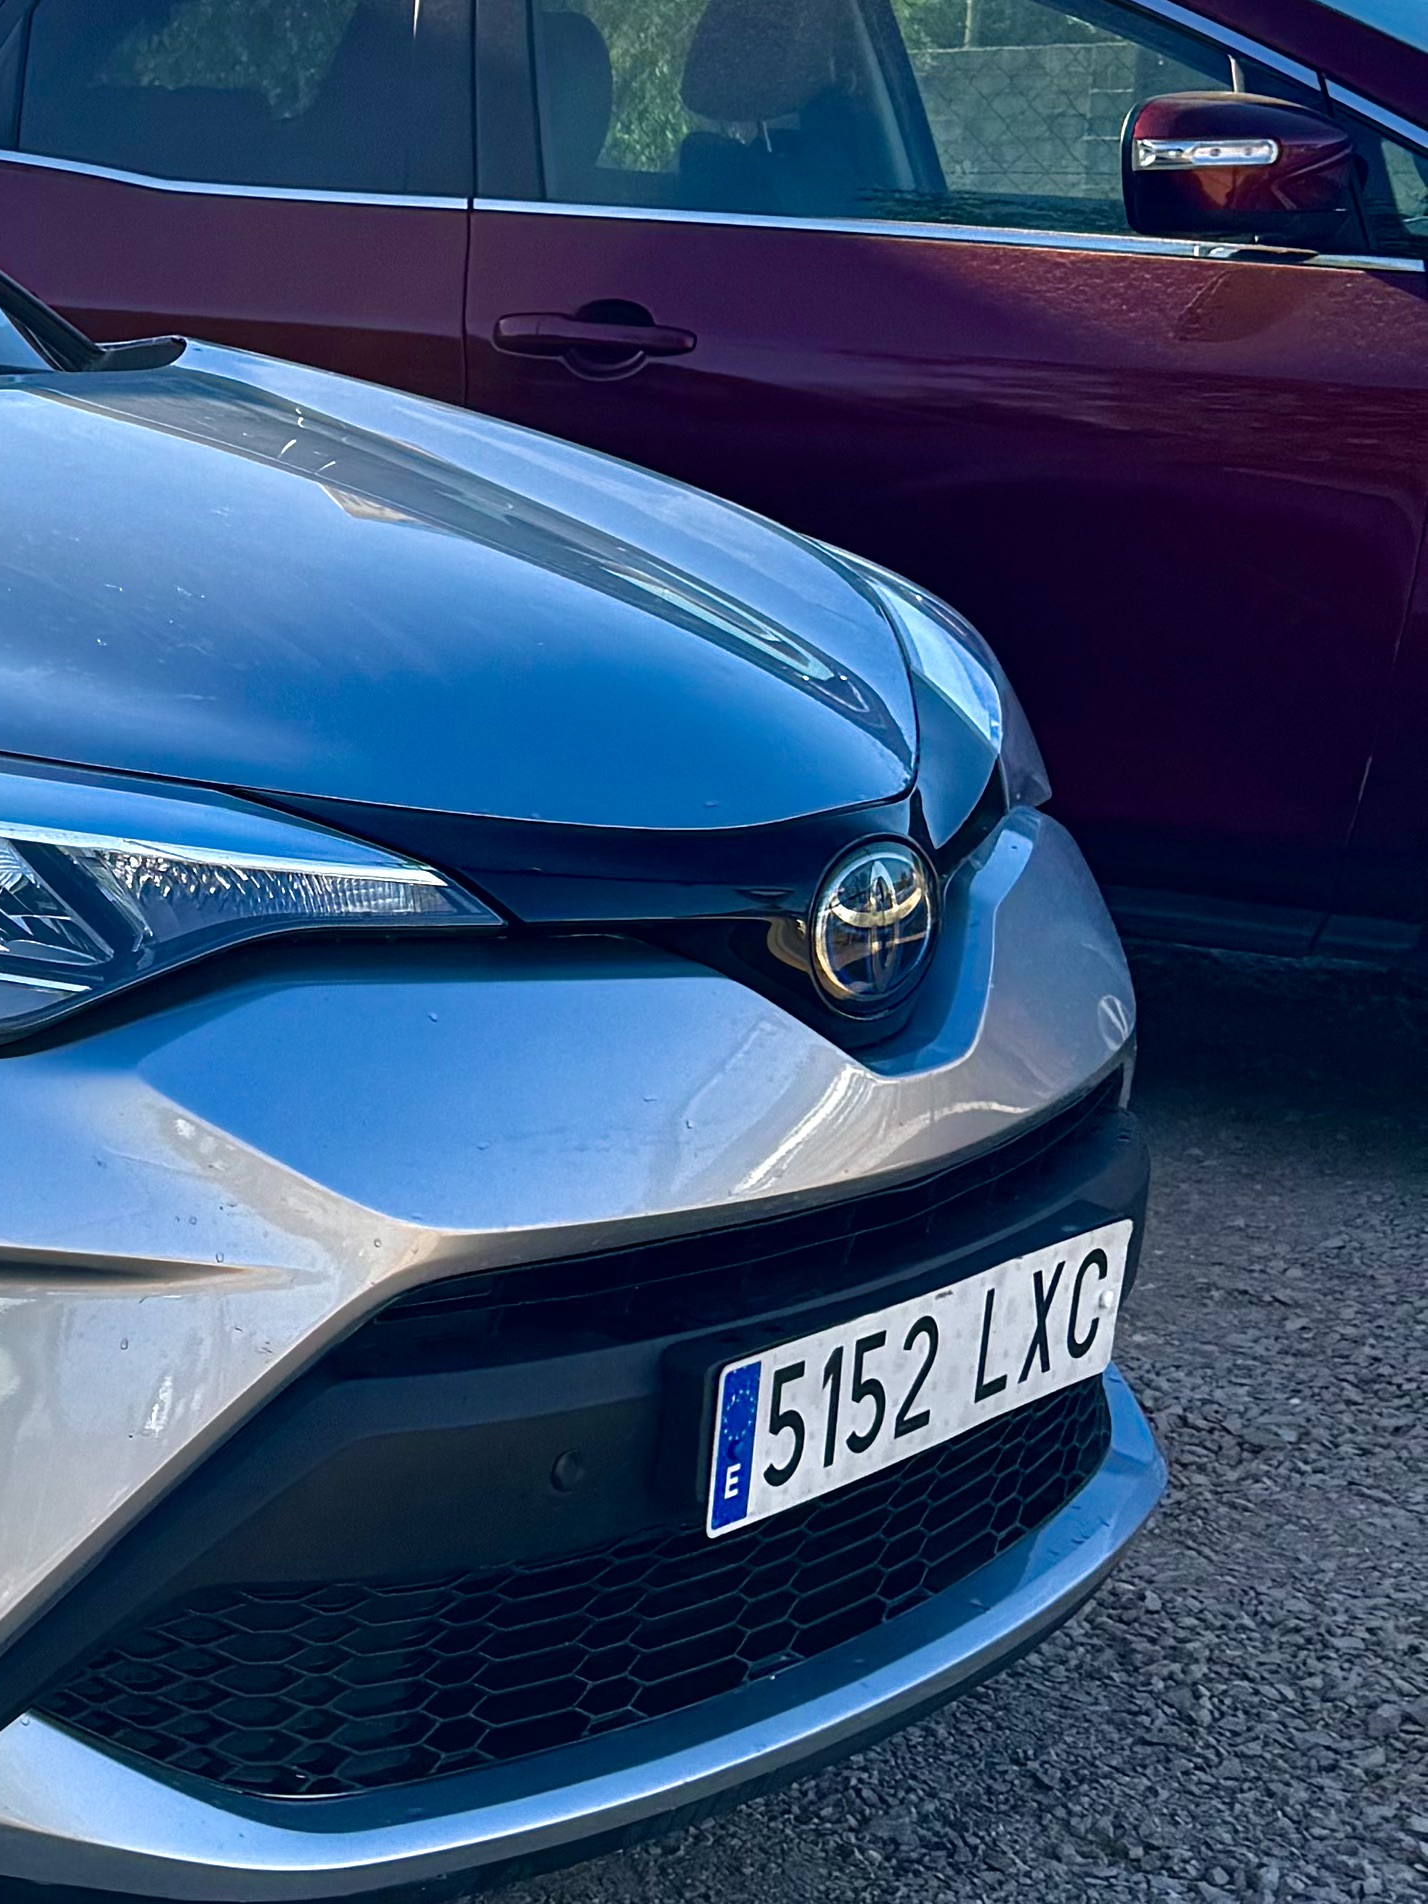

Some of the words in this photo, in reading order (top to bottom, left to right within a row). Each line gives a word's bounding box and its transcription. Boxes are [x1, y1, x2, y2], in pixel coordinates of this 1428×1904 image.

[763, 1315, 939, 1487] 5152
[974, 1248, 1109, 1404] LXC
[724, 1463, 742, 1500] E
